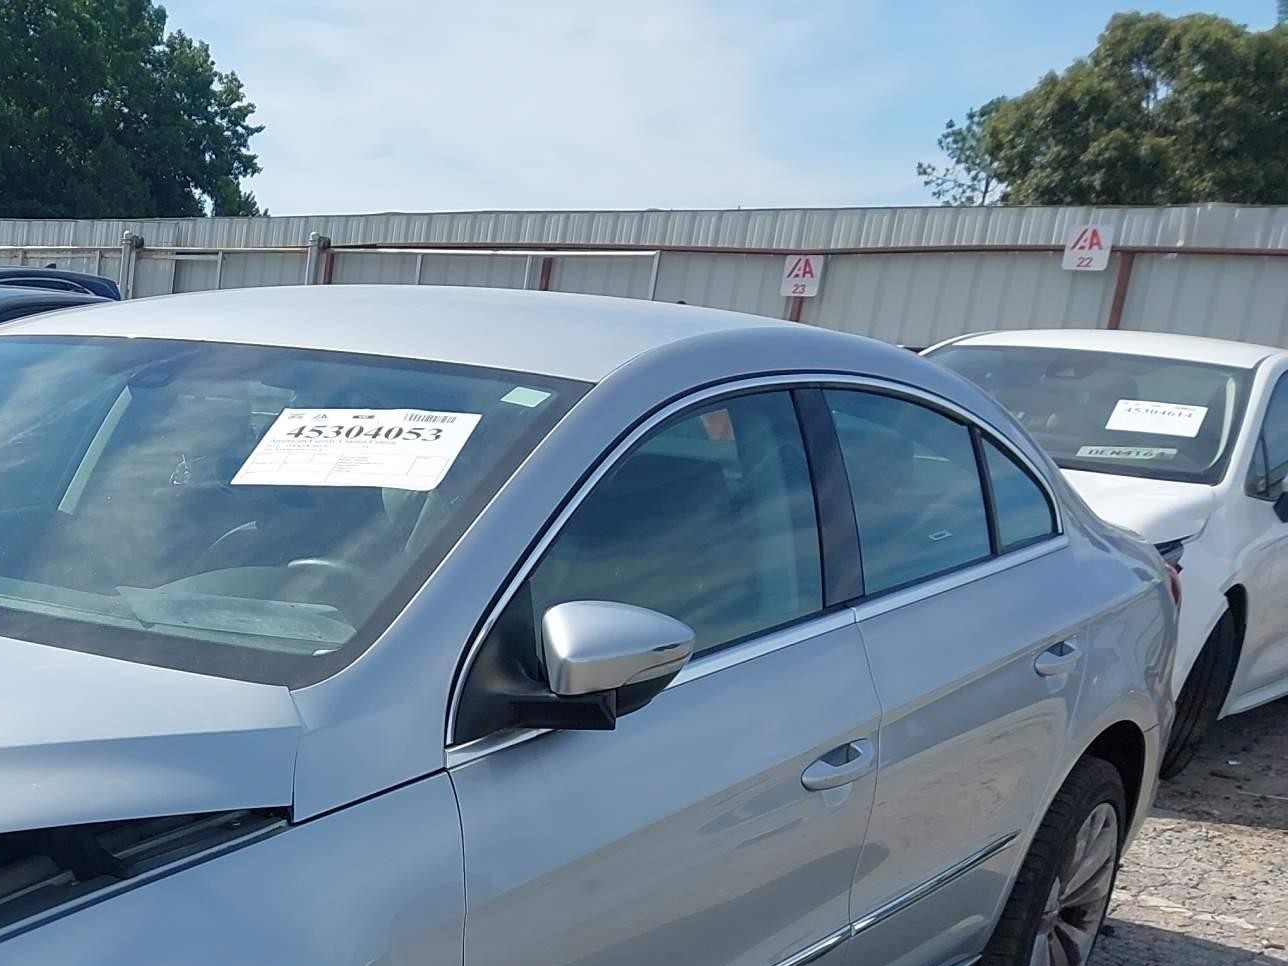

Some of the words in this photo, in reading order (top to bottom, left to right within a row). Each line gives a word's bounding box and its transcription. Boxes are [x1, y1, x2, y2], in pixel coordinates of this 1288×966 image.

[1077, 256, 1093, 268] 22
[792, 284, 806, 294] 23
[286, 425, 443, 441] 45304053
